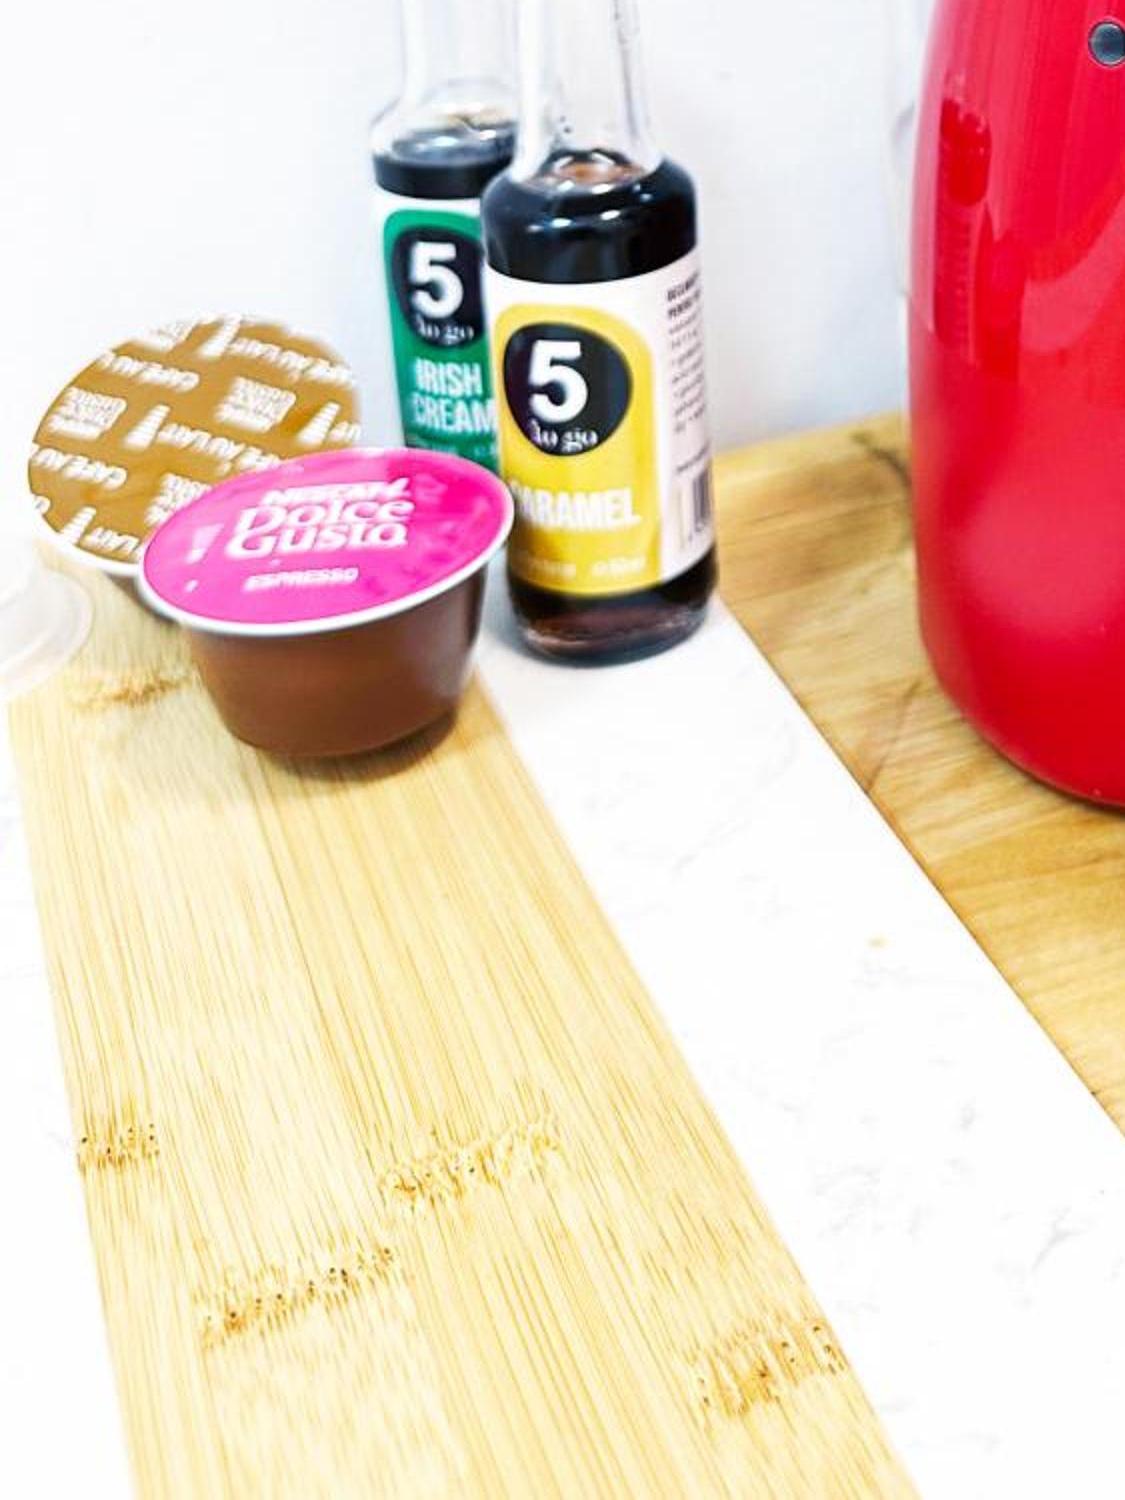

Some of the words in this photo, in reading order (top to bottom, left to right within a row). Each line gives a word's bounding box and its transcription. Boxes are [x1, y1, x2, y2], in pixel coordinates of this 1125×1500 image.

[410, 242, 464, 319] 5
[415, 357, 483, 398] IRISH
[528, 340, 588, 423] 5
[412, 392, 496, 434] CREAM
[562, 428, 598, 452] go
[235, 499, 415, 532] Dolce
[226, 523, 408, 559] Gusto
[244, 568, 359, 591] ESPRESSO
